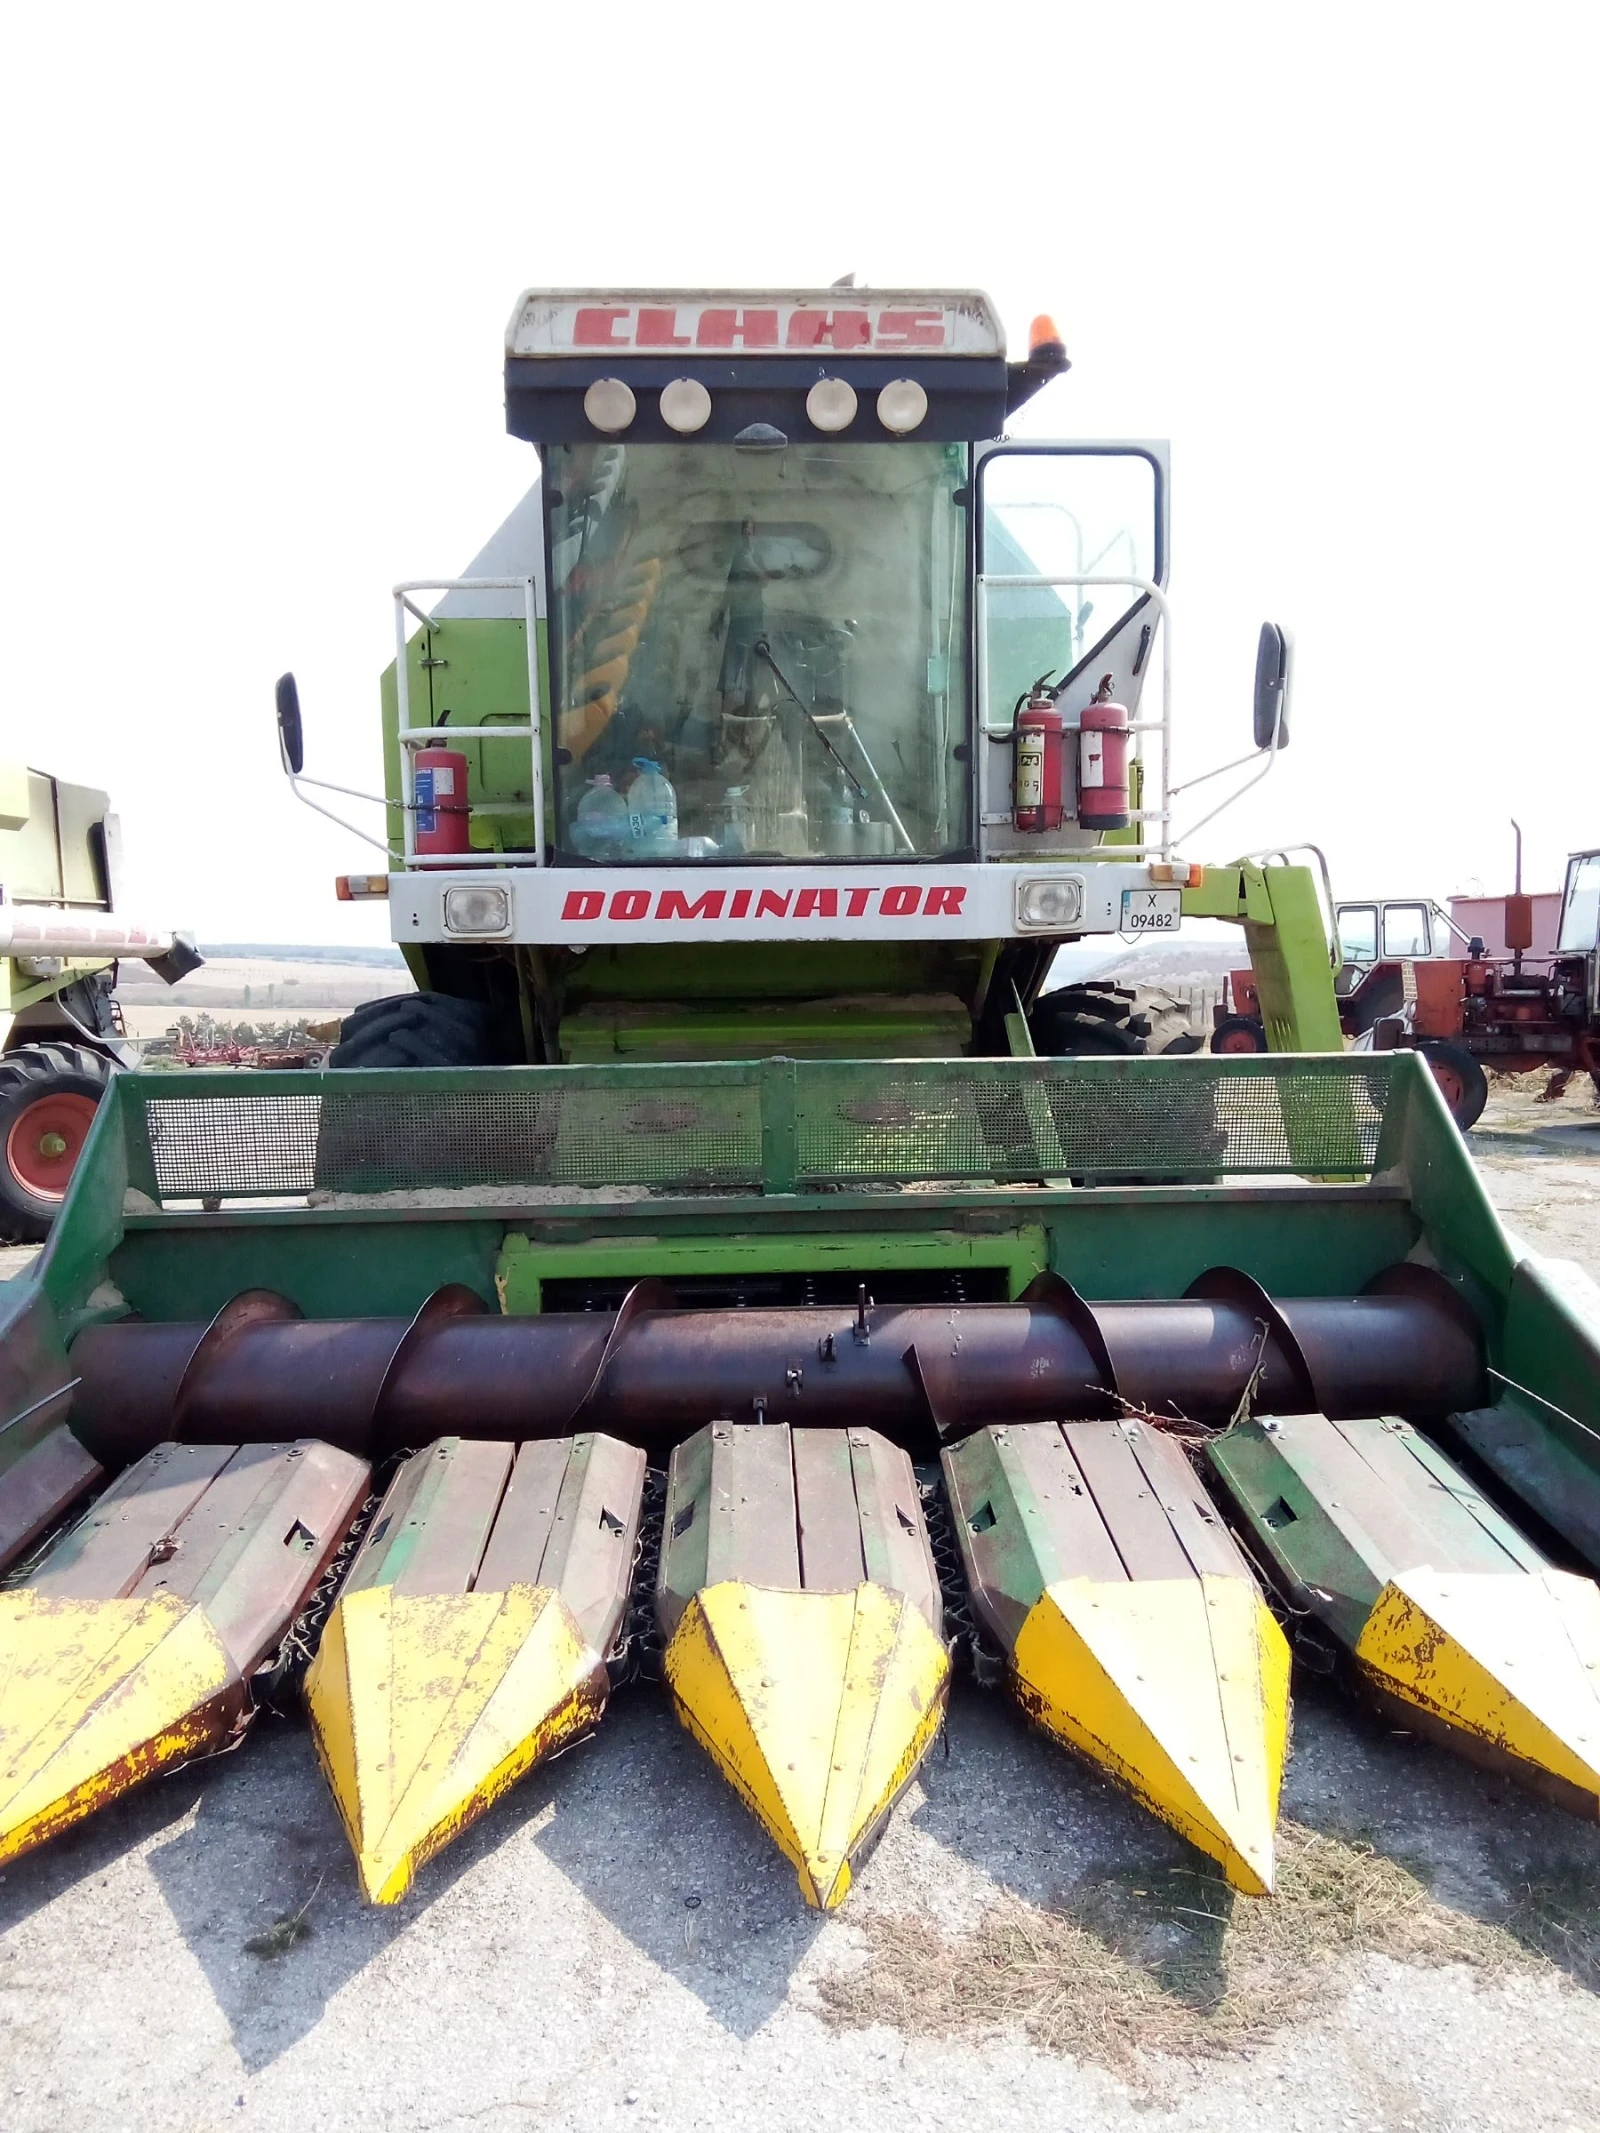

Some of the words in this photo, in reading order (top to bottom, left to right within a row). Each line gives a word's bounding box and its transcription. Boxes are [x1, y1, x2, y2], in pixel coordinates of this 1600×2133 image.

[572, 308, 946, 349] CLAAS
[560, 885, 968, 920] DOMINATOR
[1147, 894, 1158, 908] X
[1130, 913, 1173, 928] 09482
